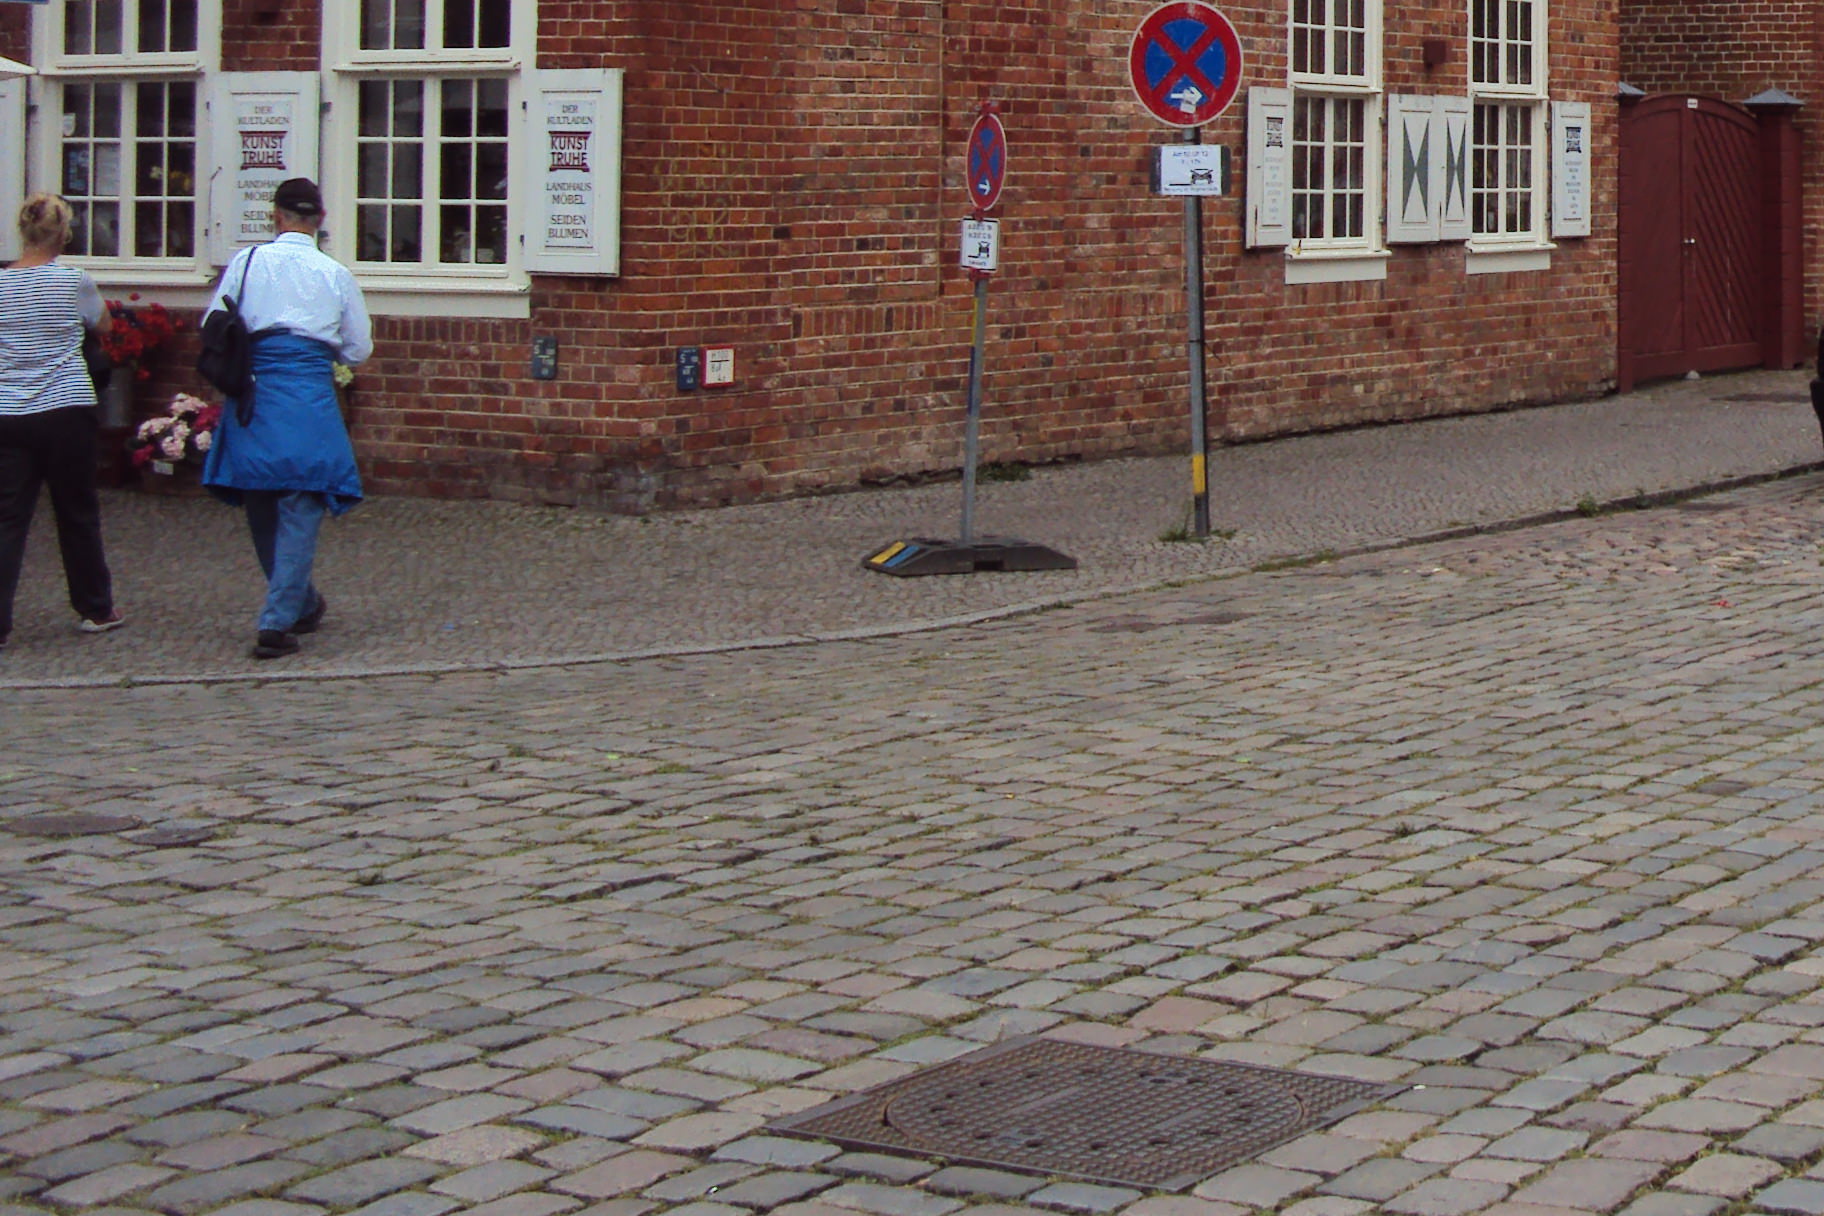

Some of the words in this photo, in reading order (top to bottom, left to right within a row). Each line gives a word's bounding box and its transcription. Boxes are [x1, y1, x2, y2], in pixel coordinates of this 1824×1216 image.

[562, 104, 579, 114] DER
[242, 135, 283, 149] KUNST
[550, 135, 588, 150] KUNST
[242, 150, 283, 164] TRUHE
[550, 151, 588, 165] TRUHE
[546, 182, 592, 191] LANDHAUS
[552, 193, 585, 205] MÖBEL
[551, 214, 586, 225] SEIDEN
[548, 227, 588, 239] BLUMEN
